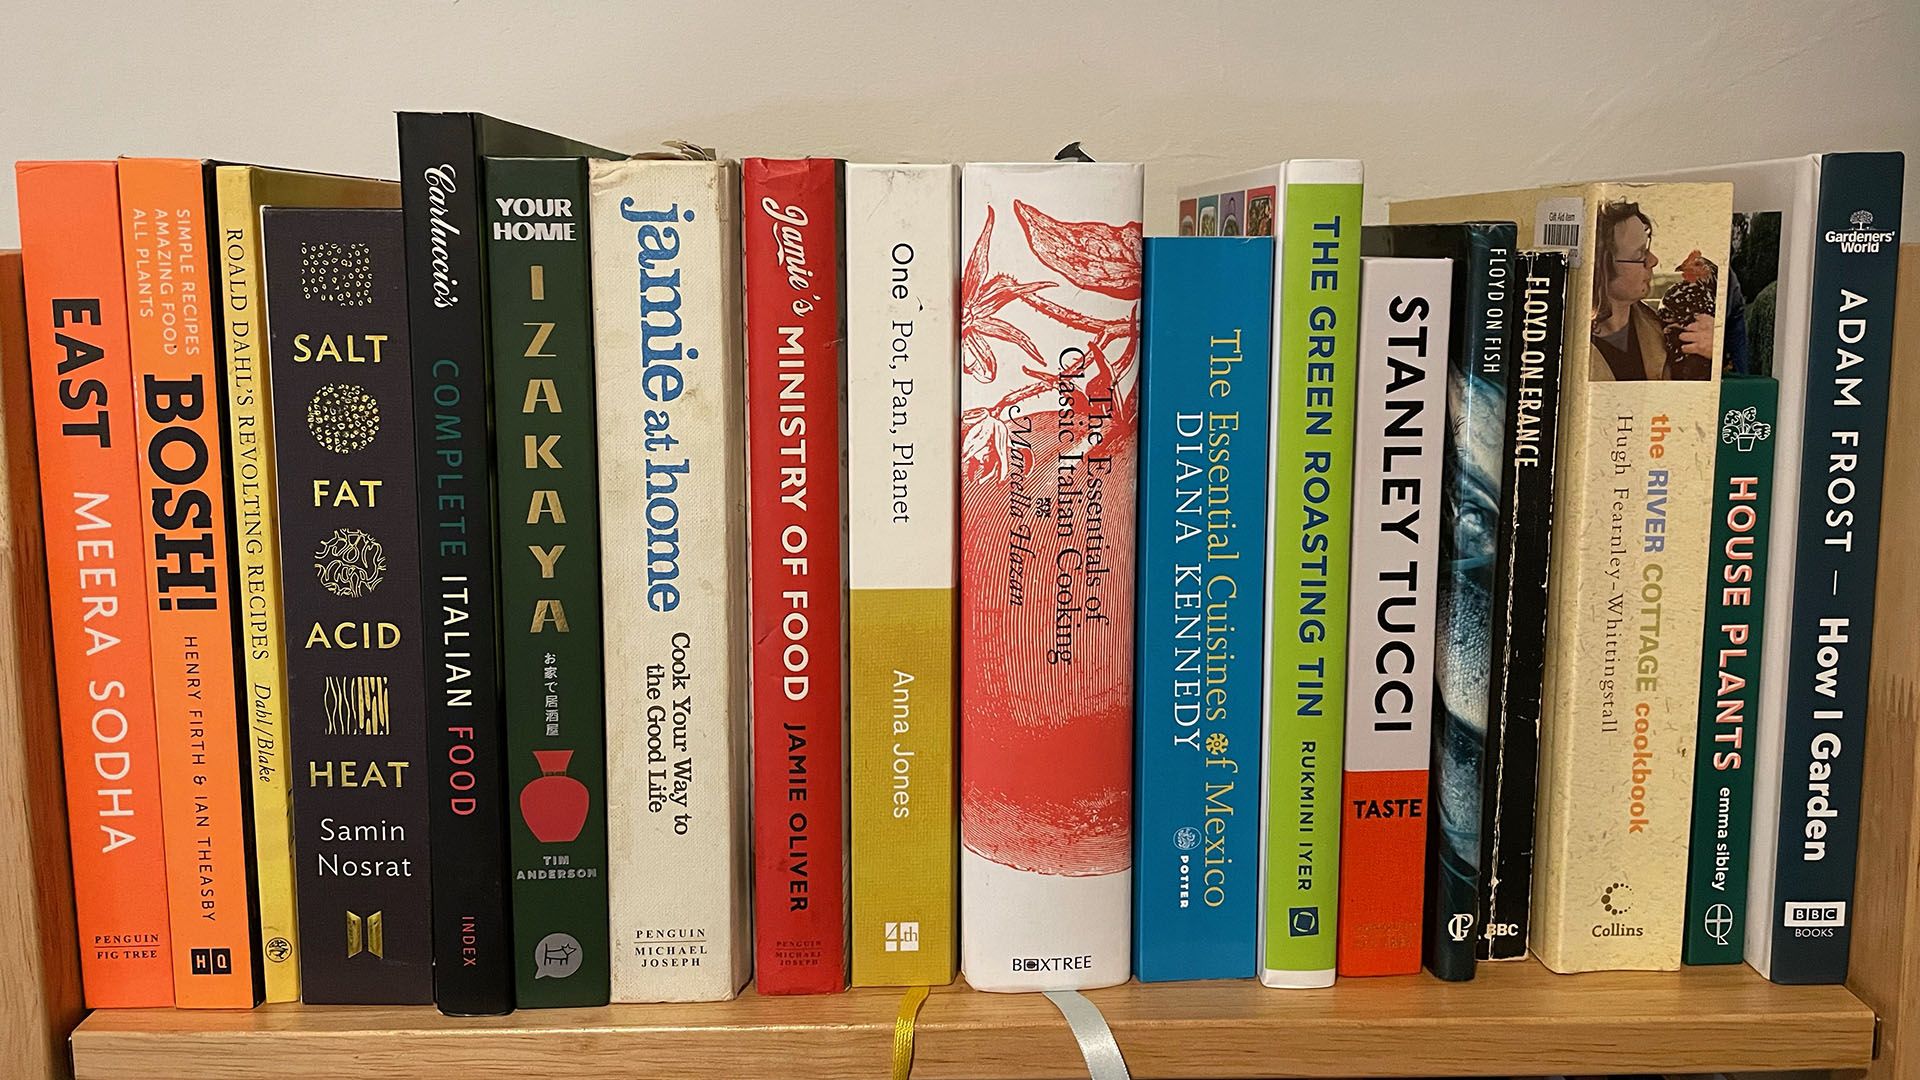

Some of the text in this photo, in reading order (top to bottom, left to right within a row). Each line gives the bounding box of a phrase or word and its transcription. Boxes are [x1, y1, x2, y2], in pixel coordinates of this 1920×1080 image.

[133, 209, 154, 317] ALL PLANTS
[424, 163, 461, 310] Carluccio's
[493, 222, 577, 241] HOME
[496, 198, 573, 217] YOUR
[762, 197, 821, 317] Jamie's
[1825, 230, 1895, 243] Gardeners'
[1840, 241, 1879, 253] World
[155, 209, 178, 355] AMAZING FOOD
[176, 209, 199, 355] SIMPLE RECIPES
[1483, 248, 1507, 373] FLOYD ON FISH
[293, 334, 388, 363] SALT
[619, 197, 699, 613] jamie at home
[889, 242, 914, 523] One Pot, Pan, Planet
[1208, 329, 1242, 399] The
[1514, 276, 1550, 467] FLOYD ON FRANCE
[1833, 289, 1868, 406] ADAM
[143, 374, 218, 611] BOSH!
[226, 228, 269, 660] ROALD DAHL'S REVOLTING RECIPES
[313, 480, 383, 508] FAT
[522, 265, 570, 633] IZAKAYA
[1207, 411, 1239, 561] Essential
[1297, 215, 1341, 717] THE GREEN ROASTING TIN
[1824, 431, 1860, 552] FROST
[1009, 405, 1036, 607] Marcella Hazan
[1047, 347, 1086, 665] Classic Italian Cooking
[1085, 387, 1112, 626] The Essentials of
[1373, 295, 1430, 732] STANLEY TUCCI
[51, 298, 137, 853] EAST MEERA SODHA
[304, 621, 401, 649] ACID
[431, 359, 476, 816] COMPLETE ITALIAN FOOD
[778, 326, 809, 912] MINISTRY OF FOOD JAMIE OLIVER
[1173, 411, 1203, 751] DIANA KENNEDY
[1599, 415, 1633, 733] Hugh Fearnley-Whittingstall
[1629, 413, 1671, 833] the RIVER COTTAGE cookbook
[1205, 575, 1237, 722] Cuisines
[1711, 476, 1758, 892] HOUSE PLANTS emma sibley
[1815, 618, 1850, 698] How
[309, 761, 409, 788] HEAT
[646, 663, 667, 813] the Good Life
[669, 632, 692, 835] Cook Your Way to
[892, 669, 915, 819] Anna Jones
[1813, 710, 1844, 720] I
[184, 636, 216, 922] HENRY FIRTH & IAN THEASBY
[320, 818, 406, 841] Samin
[1298, 741, 1316, 891] RUKMINI IYER
[1353, 799, 1423, 819] TASTE
[1803, 733, 1842, 861] Garden
[318, 854, 412, 877] Nosrat
[516, 868, 597, 881] ANDERSON
[543, 855, 570, 866] TIM
[1178, 855, 1189, 908] POTTER
[1203, 783, 1236, 909] Mexico
[95, 933, 159, 944] PENGUIN
[97, 950, 158, 960] FIG TREE
[461, 916, 477, 967] INDEX
[635, 945, 707, 956] MICHAEL
[636, 928, 706, 939] PENGUIN
[641, 958, 701, 967] JOSEPH
[1486, 923, 1519, 937] BBC
[1592, 924, 1643, 938] Collins
[1793, 907, 1838, 921] BBC
[1795, 928, 1834, 938] BOOKS
